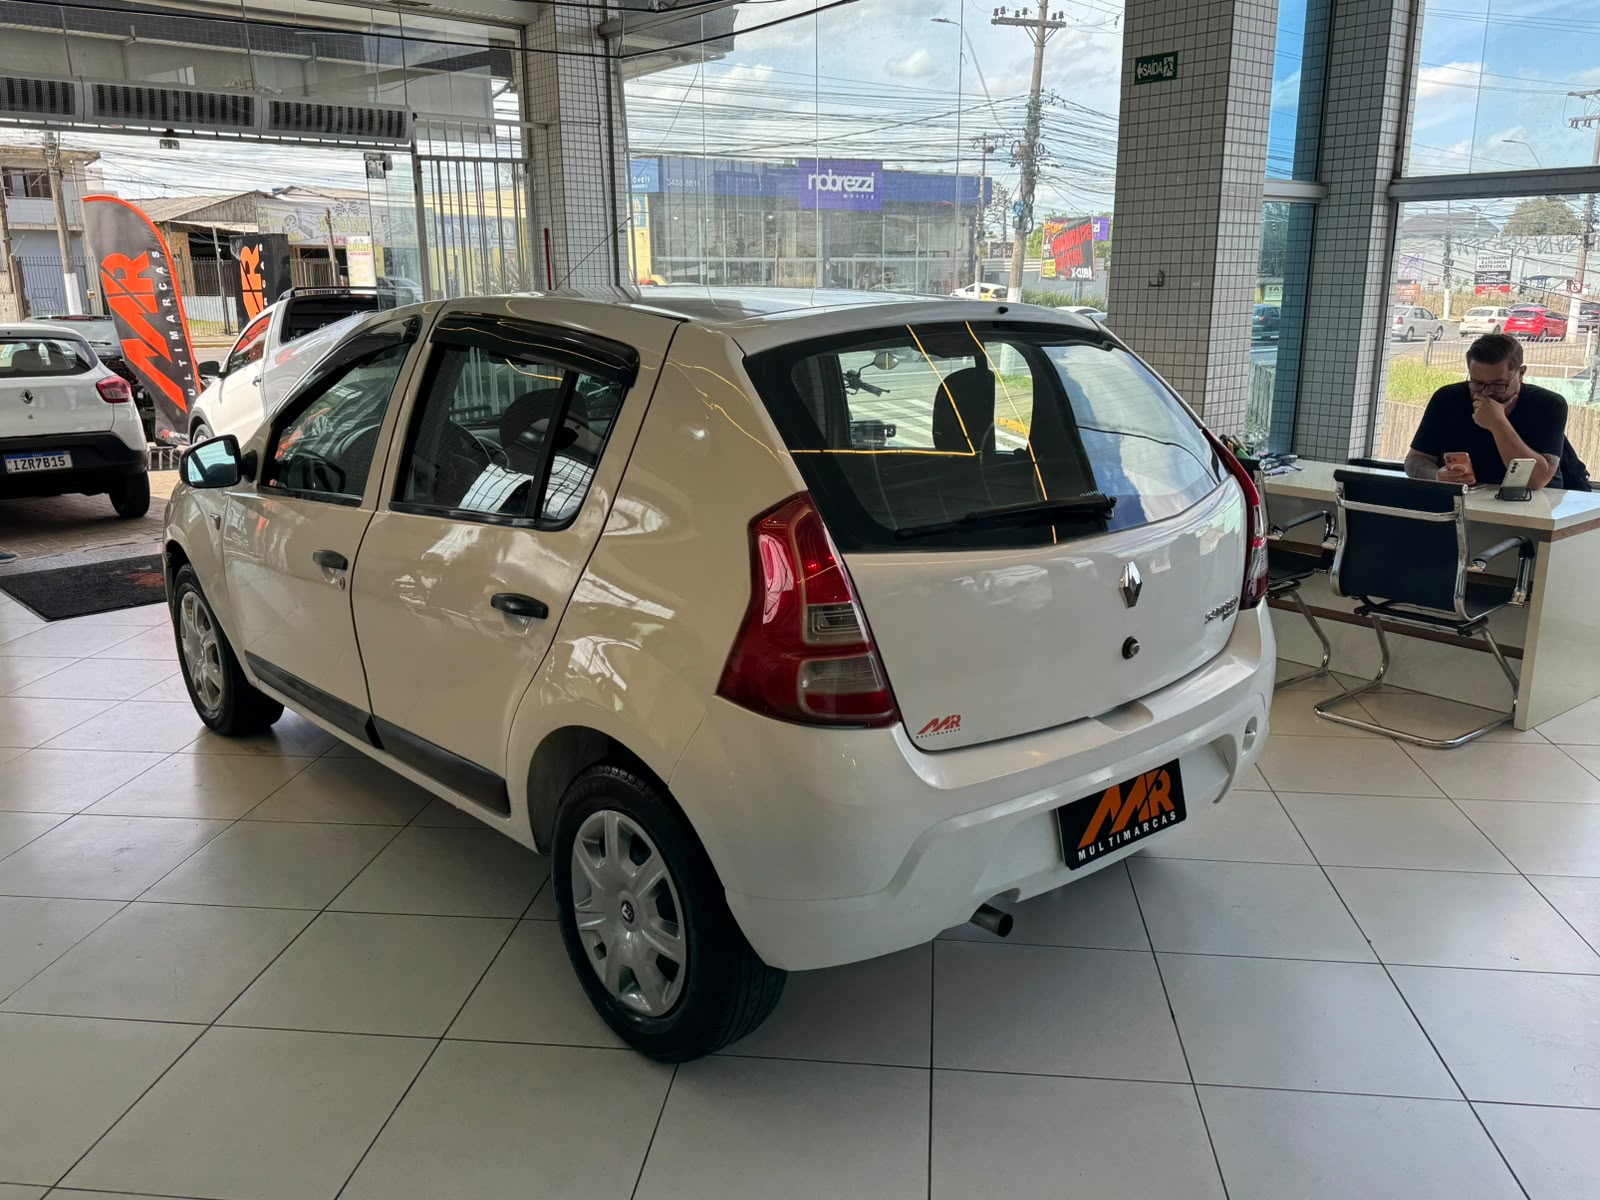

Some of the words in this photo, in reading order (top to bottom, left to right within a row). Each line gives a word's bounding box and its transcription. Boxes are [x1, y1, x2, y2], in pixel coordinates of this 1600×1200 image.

[1142, 59, 1164, 77] SAÍDA
[808, 168, 875, 193] nobrezzi
[152, 250, 196, 396] MULTIMARCAS
[14, 456, 66, 471] IZR7B15
[1077, 769, 1175, 849] MR
[1078, 811, 1176, 861] MULTIMARCAS
